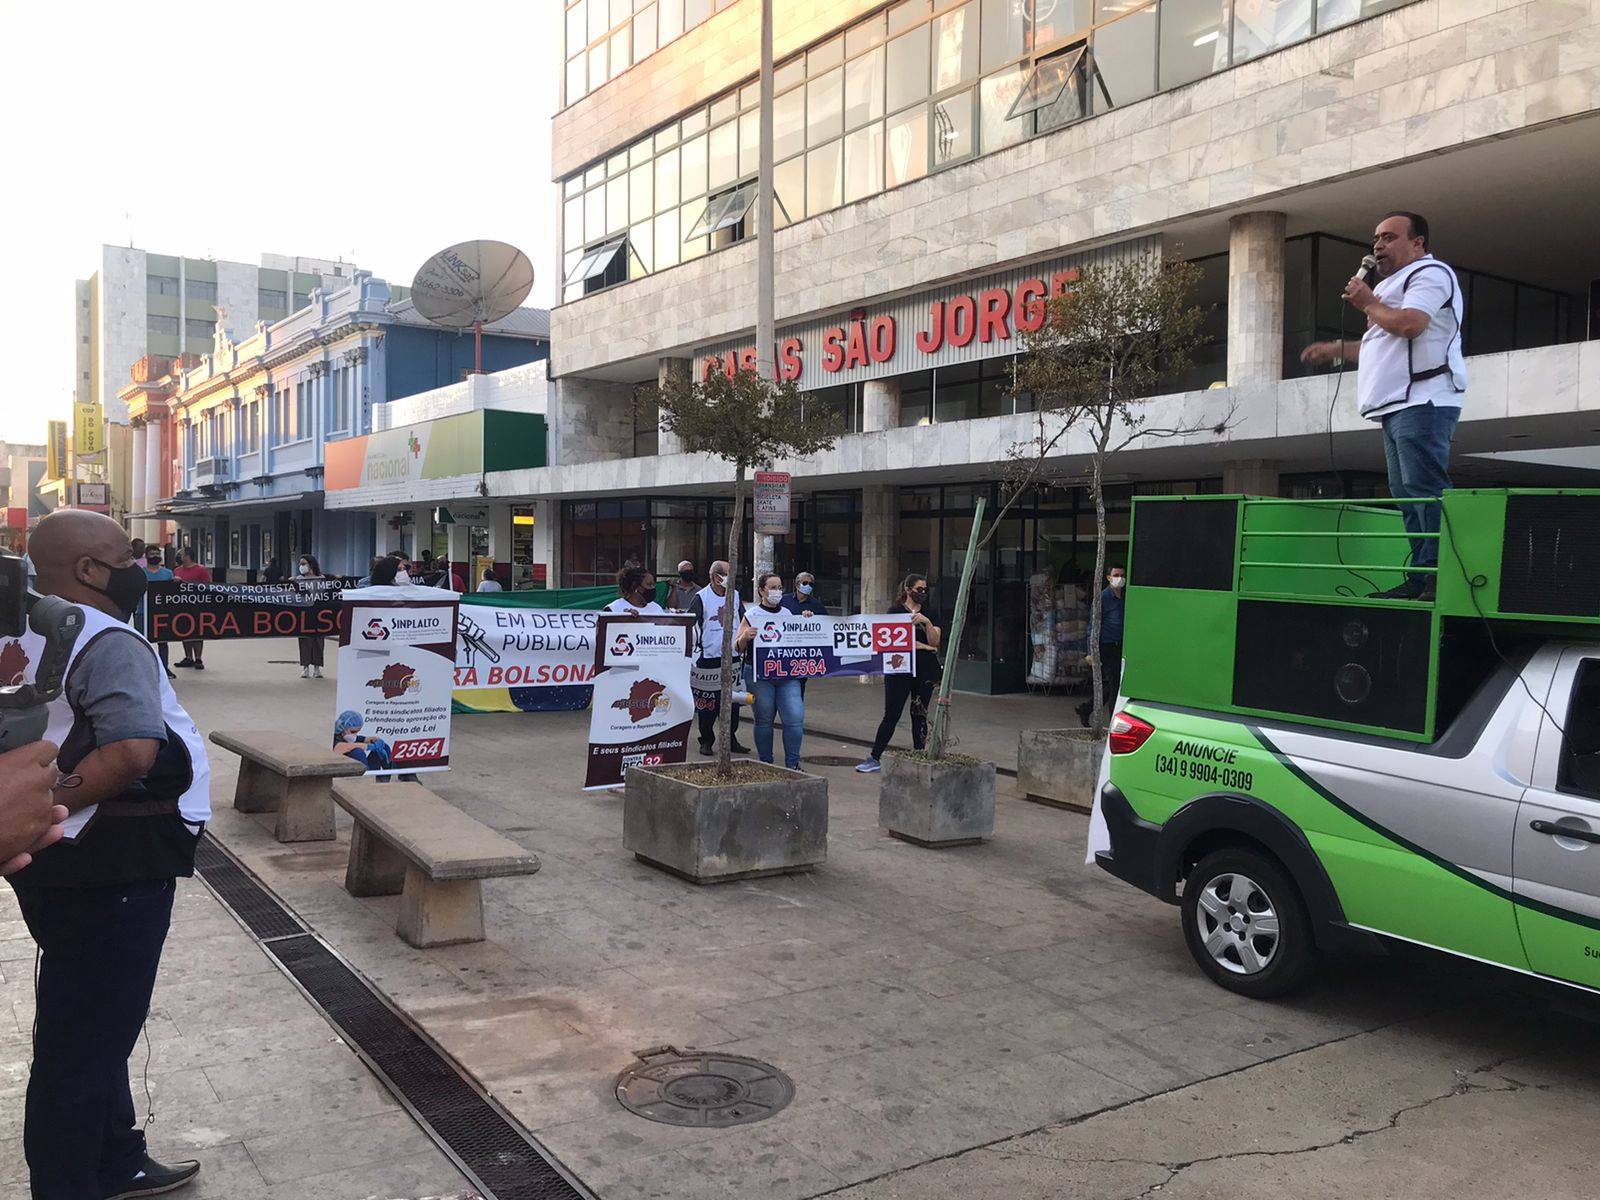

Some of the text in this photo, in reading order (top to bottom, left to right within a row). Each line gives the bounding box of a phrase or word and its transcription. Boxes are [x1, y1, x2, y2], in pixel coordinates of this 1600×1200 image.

[822, 309, 896, 372] SÃO
[916, 269, 1081, 353] JORGE
[367, 456, 411, 480] nacional
[180, 583, 193, 592] SE
[197, 583, 206, 592] O
[209, 584, 239, 593] POVO
[242, 583, 296, 593] PROTESTA
[299, 581, 314, 590] EM
[317, 580, 342, 590] MEIO
[344, 580, 351, 588] A
[155, 593, 162, 604] É
[165, 594, 212, 604] PORQUE
[215, 595, 223, 603] O
[228, 594, 292, 604] PRESIDENTE
[295, 592, 302, 603] É
[305, 593, 329, 602] MAIS
[153, 611, 240, 639] FORA
[495, 612, 597, 629] EM DEFES
[833, 623, 867, 631] CONTRA
[502, 631, 590, 651] PÚBLICA
[834, 631, 872, 649] PEC
[877, 627, 908, 647] 32
[767, 648, 823, 658] A FAVOR DA
[453, 664, 597, 686] RA BOLSONA
[691, 671, 719, 681] PLALTO
[764, 659, 827, 678] PL 2564
[424, 706, 447, 714] filiados
[695, 698, 715, 711] 64
[406, 715, 437, 723] aprovação
[375, 724, 437, 736] Projeto de Lei
[394, 740, 441, 759] 2564
[593, 747, 599, 755] E
[621, 743, 656, 753] sindicatos
[658, 740, 683, 749] filiados
[1173, 740, 1239, 764] ANUNCIE
[645, 756, 661, 766] 32
[1155, 754, 1253, 791] (34) 9 9904-0309
[1584, 946, 1600, 958] Su
